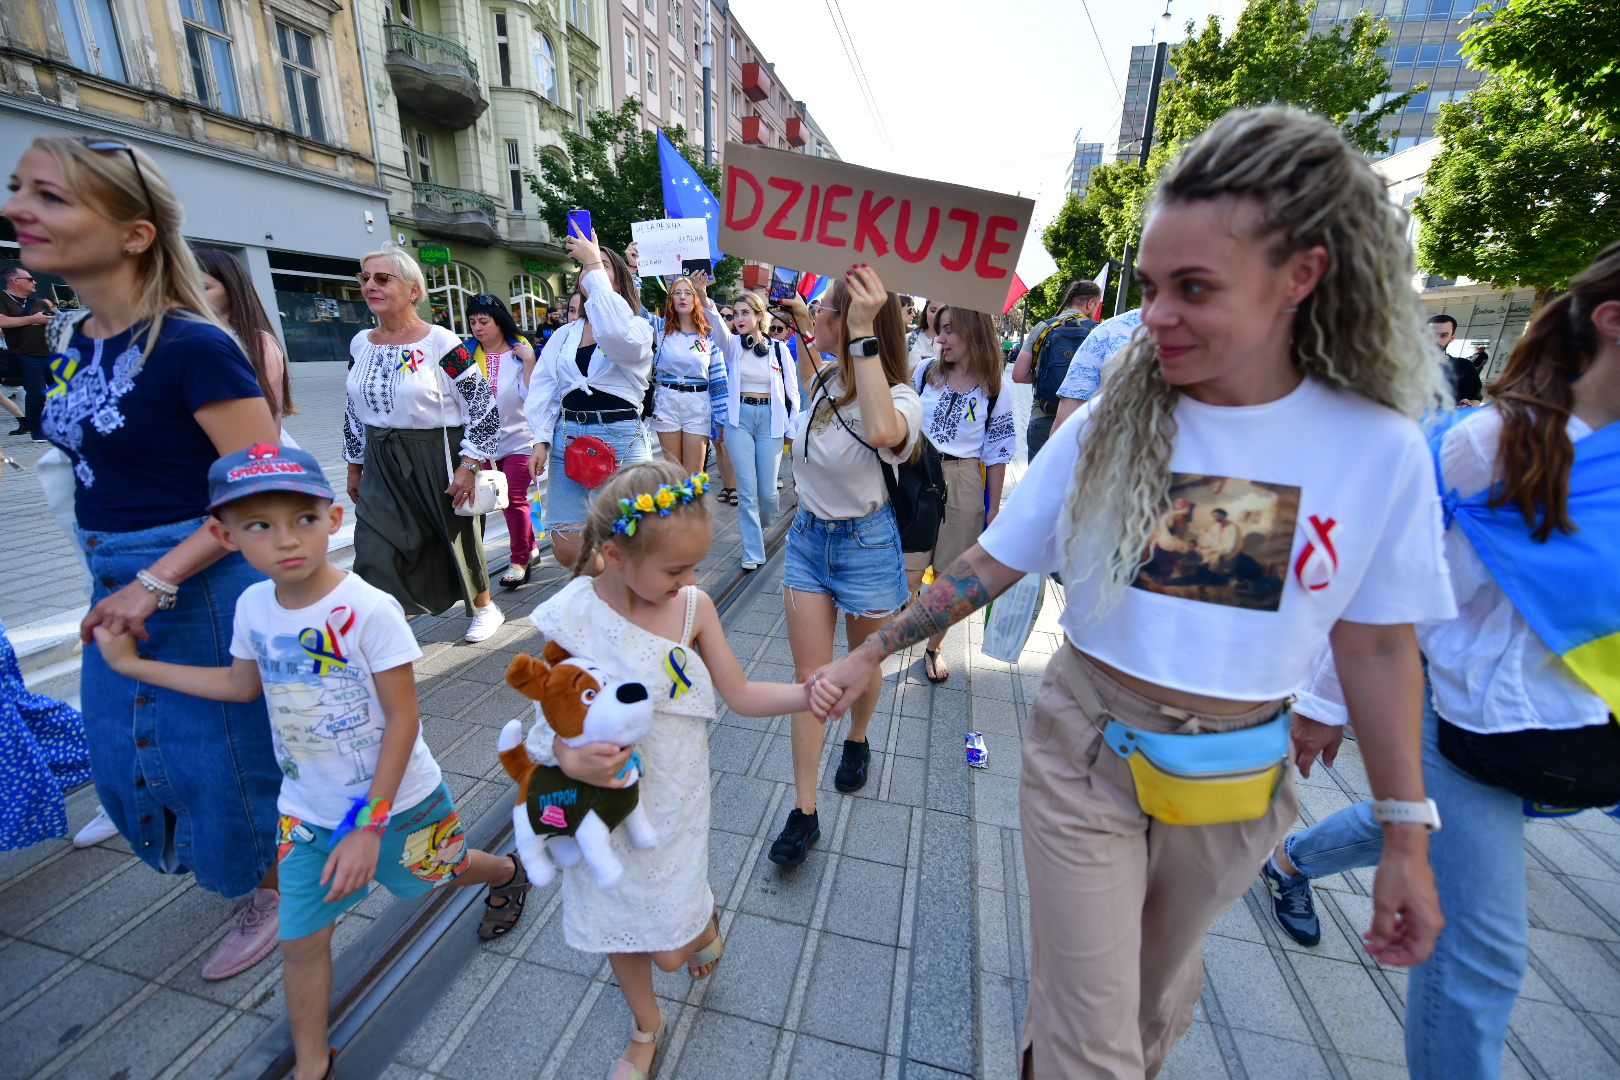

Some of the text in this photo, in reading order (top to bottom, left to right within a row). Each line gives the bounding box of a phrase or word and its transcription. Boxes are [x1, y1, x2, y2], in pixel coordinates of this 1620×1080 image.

[725, 165, 1018, 279] DZIEKUJE
[420, 249, 447, 259] żabka
[333, 689, 363, 702] WEST
[325, 714, 361, 732] NORTH
[349, 734, 375, 750] EAST
[539, 788, 578, 811] ПАТРОН
